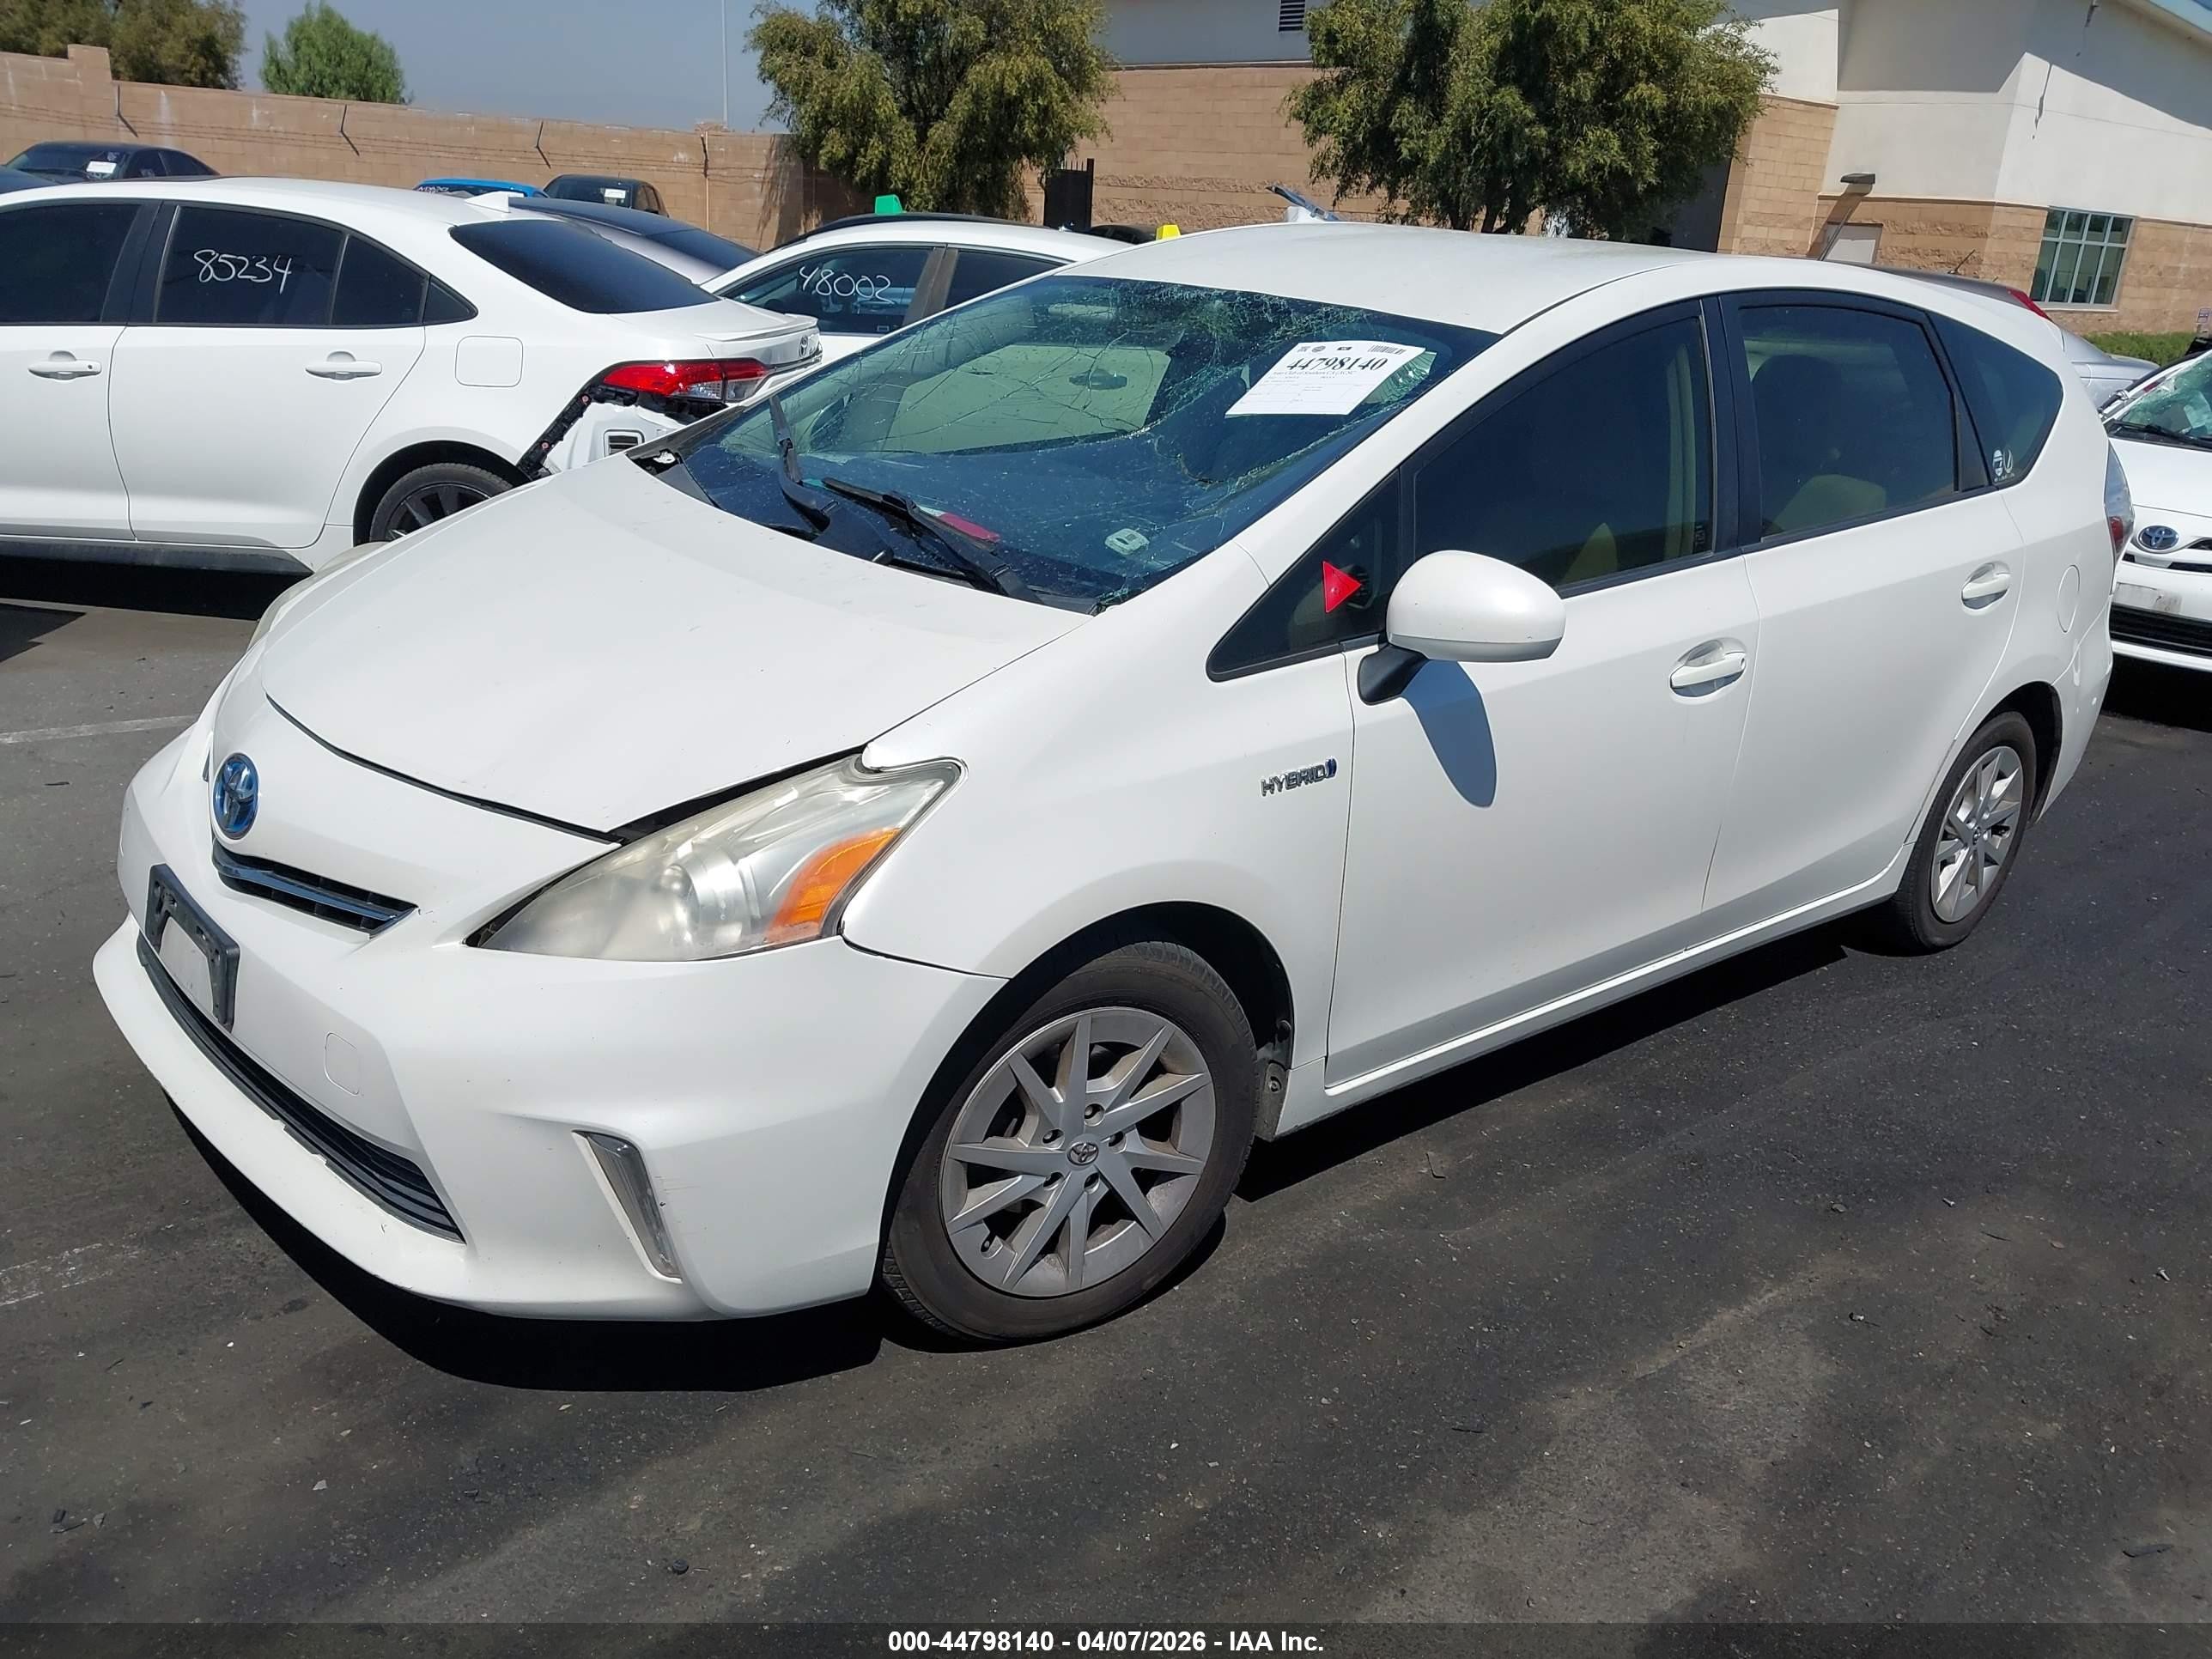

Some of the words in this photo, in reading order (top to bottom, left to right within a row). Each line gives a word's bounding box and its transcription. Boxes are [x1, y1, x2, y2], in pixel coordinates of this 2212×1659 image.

[193, 249, 292, 295] 85234
[799, 265, 896, 305] 48002
[1286, 356, 1389, 371] 44798140
[1261, 764, 1327, 797] HYBRID
